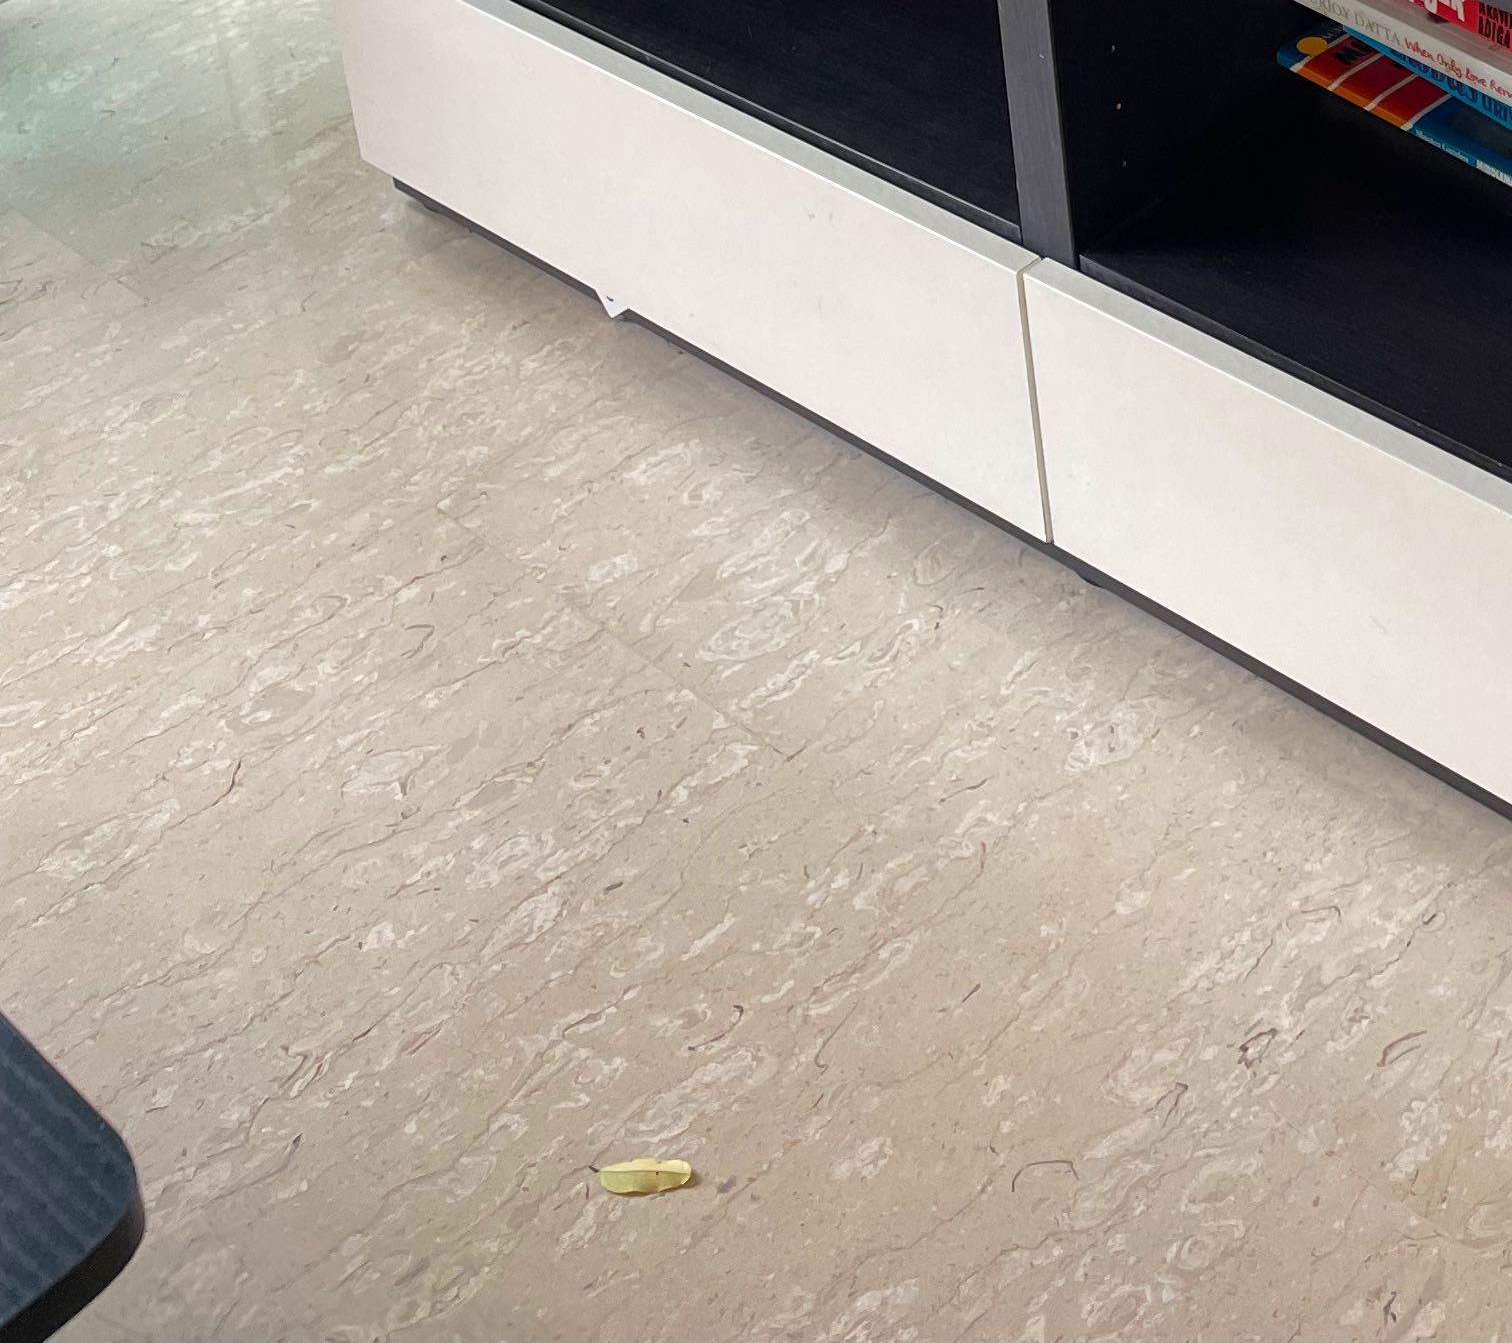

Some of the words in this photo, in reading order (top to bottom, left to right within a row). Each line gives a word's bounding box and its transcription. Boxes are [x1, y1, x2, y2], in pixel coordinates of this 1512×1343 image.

[1354, 8, 1402, 44] DATTA
[1478, 16, 1512, 50] ADIGA
[1404, 37, 1434, 61] When
[1436, 52, 1463, 78] Only
